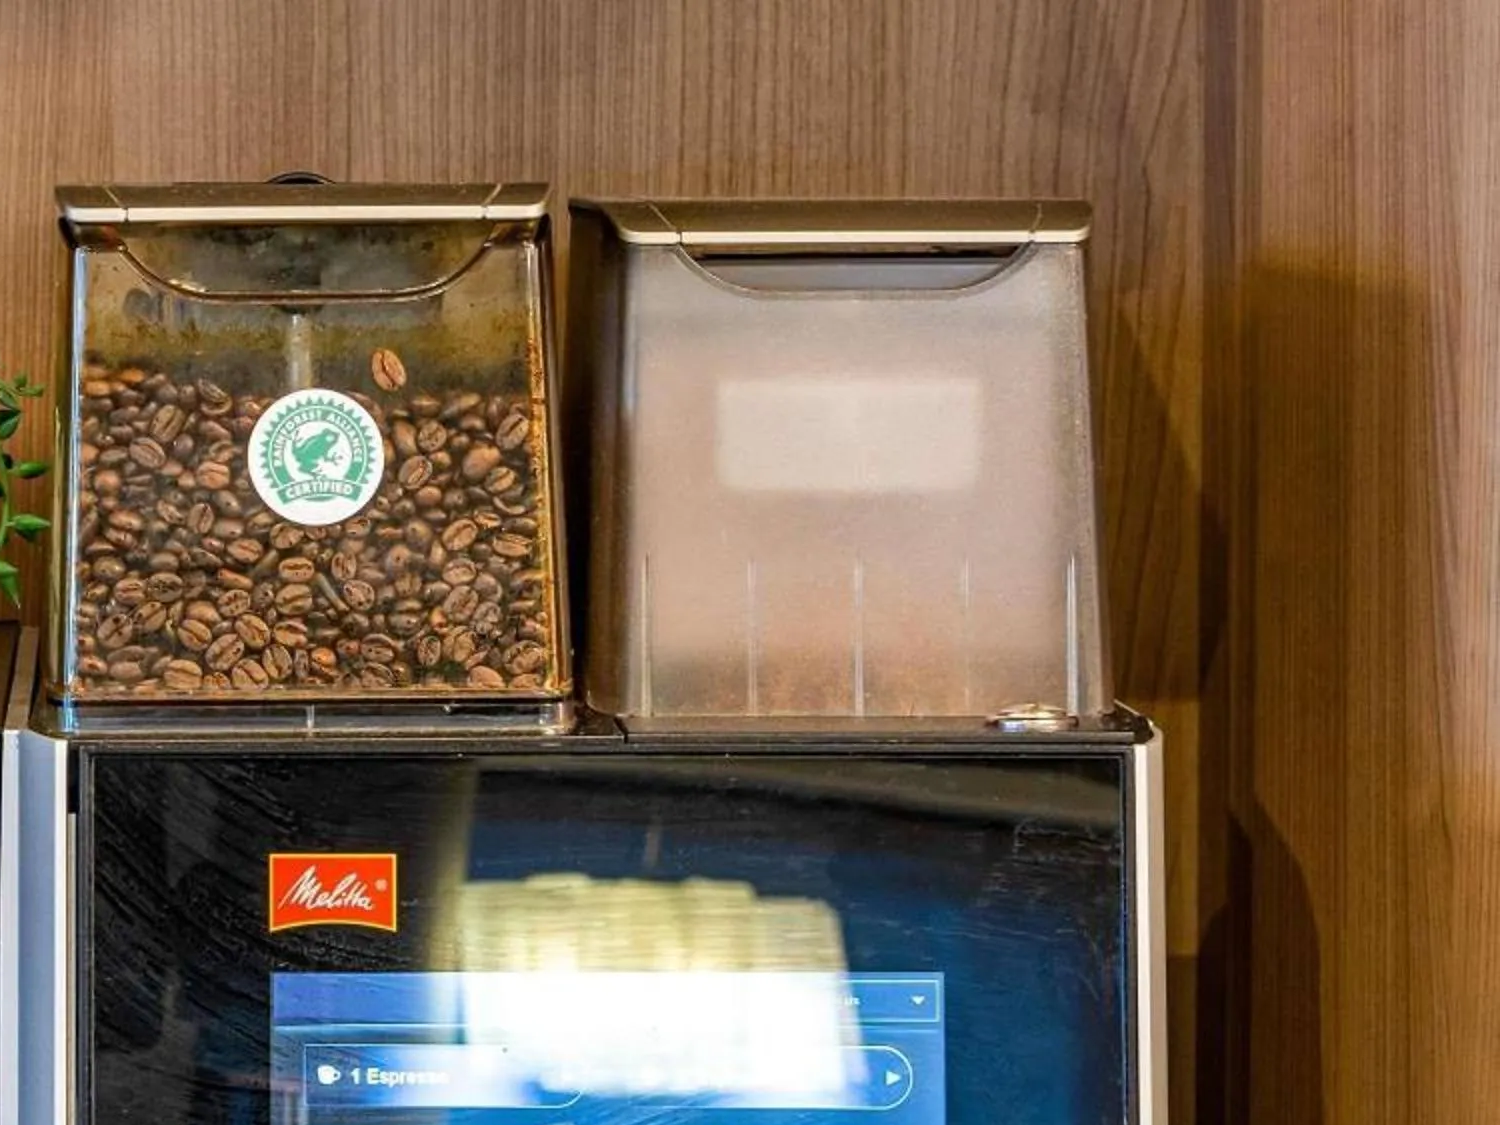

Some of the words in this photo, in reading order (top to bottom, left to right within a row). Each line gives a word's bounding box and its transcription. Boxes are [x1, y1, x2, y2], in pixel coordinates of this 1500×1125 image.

[285, 481, 353, 497] CERTIFIED
[277, 864, 376, 911] Melitta
[351, 1067, 361, 1085] 1
